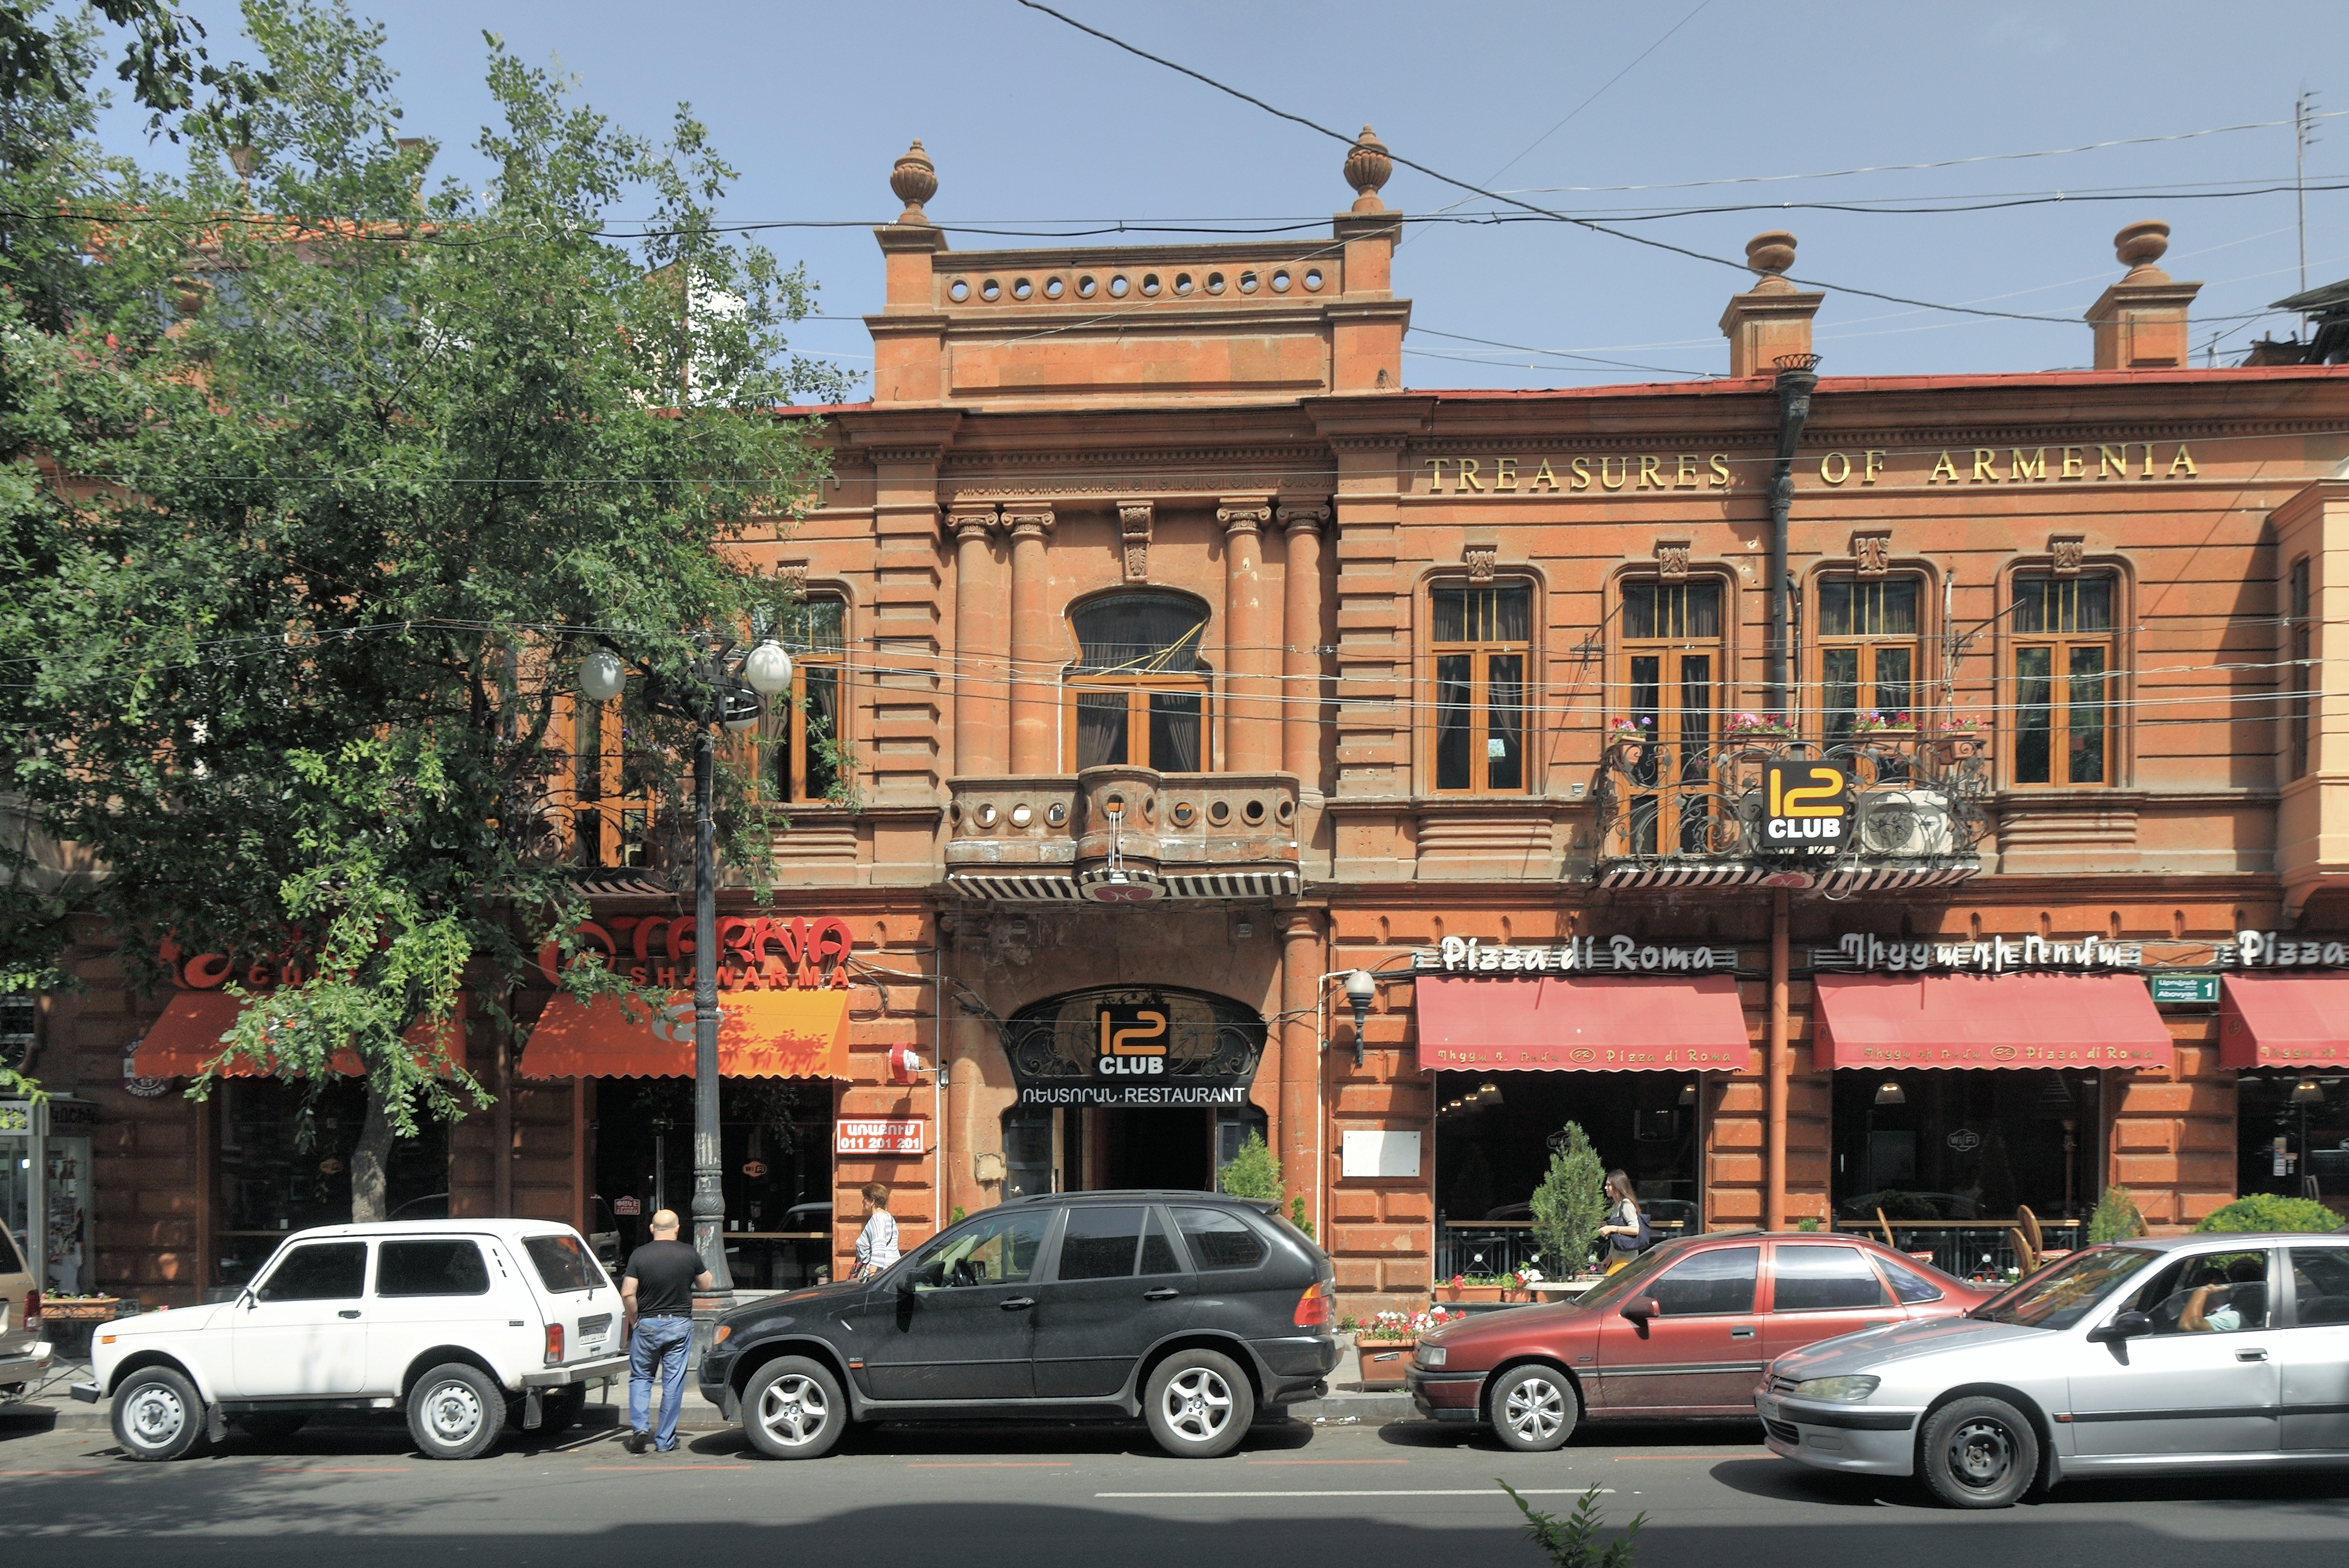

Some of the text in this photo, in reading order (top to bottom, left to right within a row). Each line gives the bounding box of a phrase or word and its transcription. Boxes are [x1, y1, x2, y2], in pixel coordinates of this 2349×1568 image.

[1424, 444, 2199, 490] TREASURES OF ARMENIA
[1769, 767, 1844, 817] 12
[1768, 818, 1840, 839] CLUB
[1442, 934, 1715, 971] Pizza di Roma
[2238, 930, 2347, 966] Pizza
[2204, 982, 2213, 997] 1
[1100, 1011, 1166, 1055] 12
[1606, 1049, 1731, 1063] Pizza di Roma
[2026, 1046, 2153, 1060] Pizza di Roma
[1099, 1057, 1164, 1074] CLUB
[1124, 1087, 1246, 1103] RESTAURANT
[840, 1137, 919, 1149] 011 201 201
